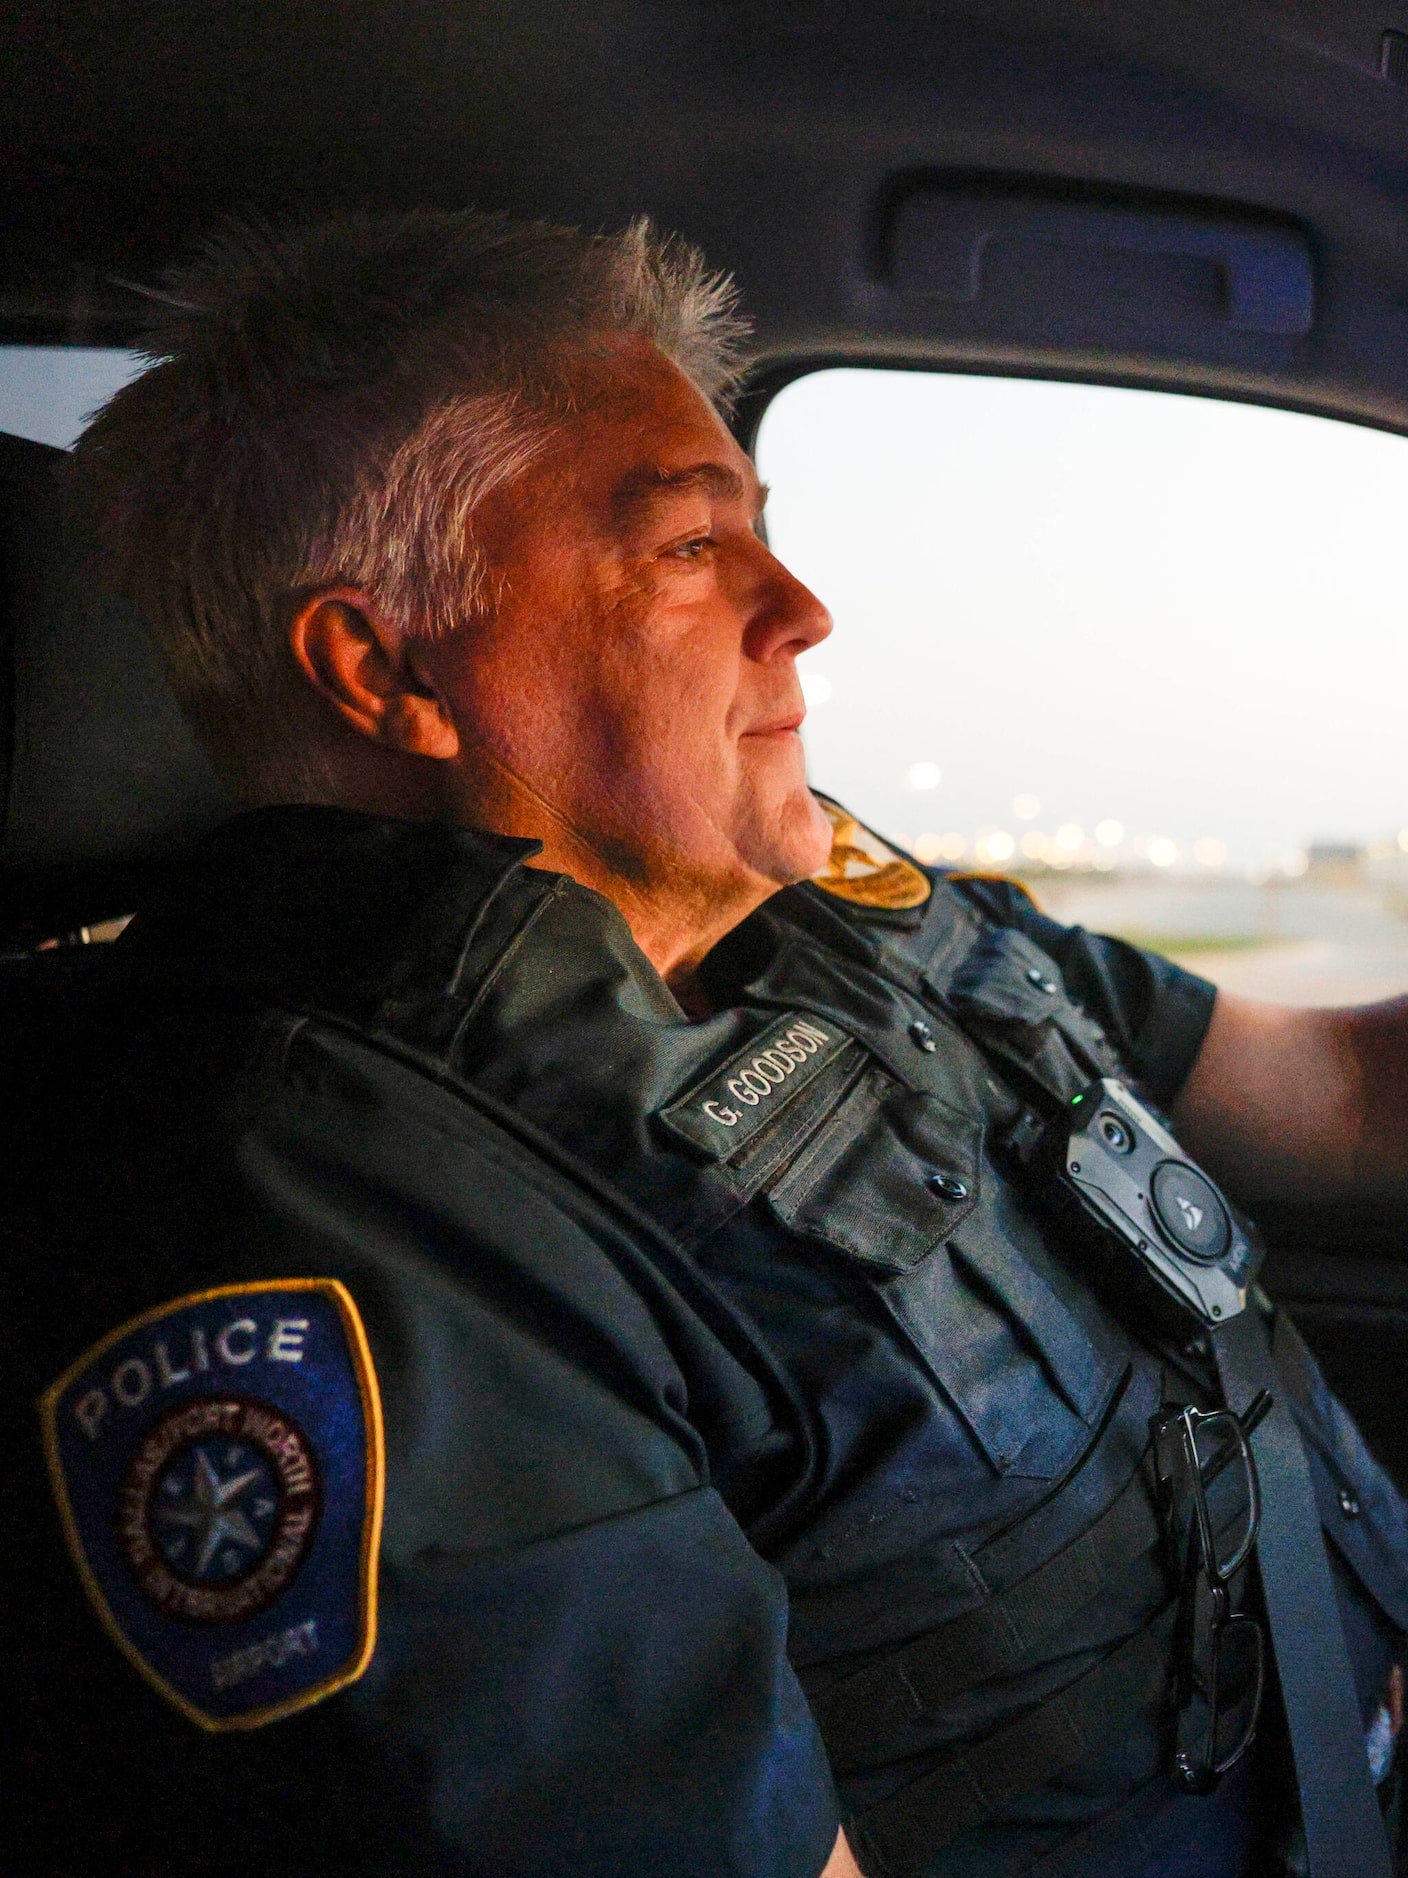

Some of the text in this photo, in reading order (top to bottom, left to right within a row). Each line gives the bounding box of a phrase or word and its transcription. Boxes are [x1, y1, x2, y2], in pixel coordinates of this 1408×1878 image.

[702, 1020, 829, 1127] G. GOODSON
[74, 1317, 310, 1440] POLICE
